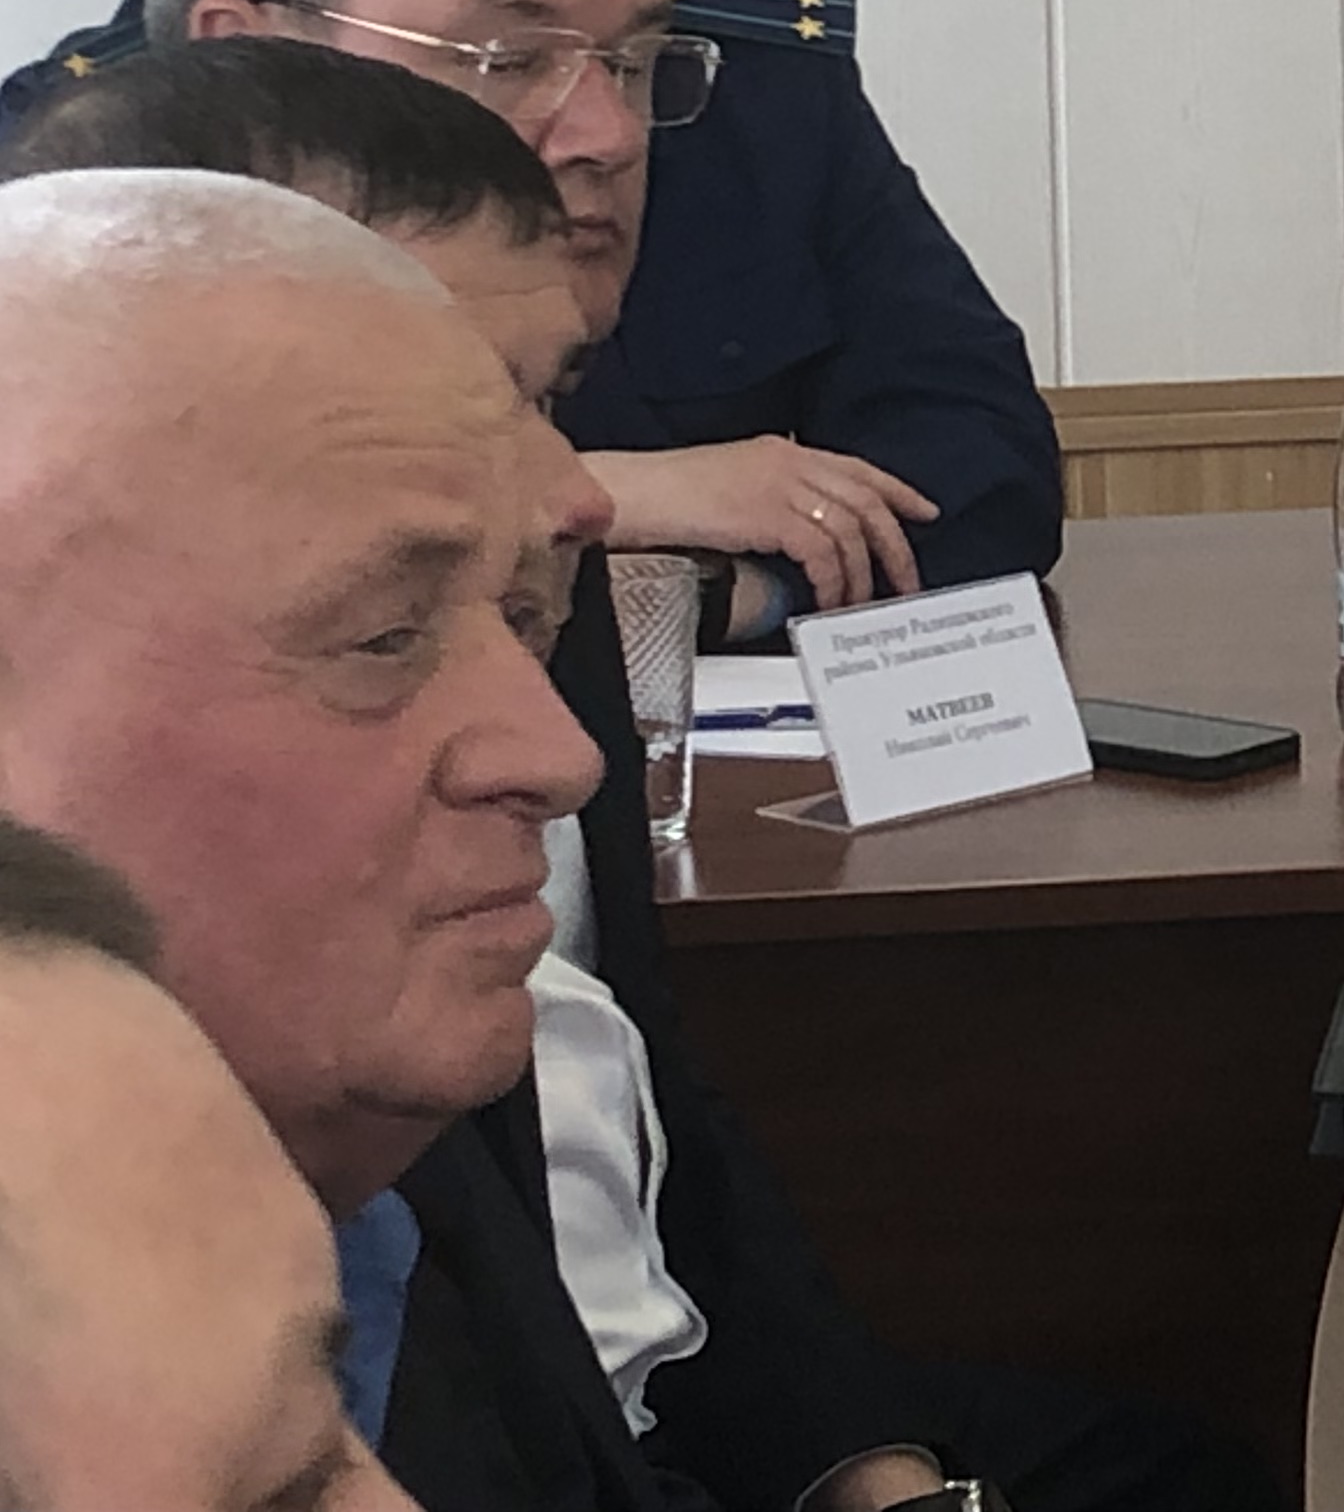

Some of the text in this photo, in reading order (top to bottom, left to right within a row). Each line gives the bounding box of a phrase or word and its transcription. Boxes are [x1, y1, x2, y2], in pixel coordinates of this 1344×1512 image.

[825, 622, 1037, 684] района Ульяновской области
[831, 622, 907, 653] Прокурор
[906, 692, 995, 726] МАТВЕЕВ
[884, 714, 1031, 759] Николай Сергеевич
